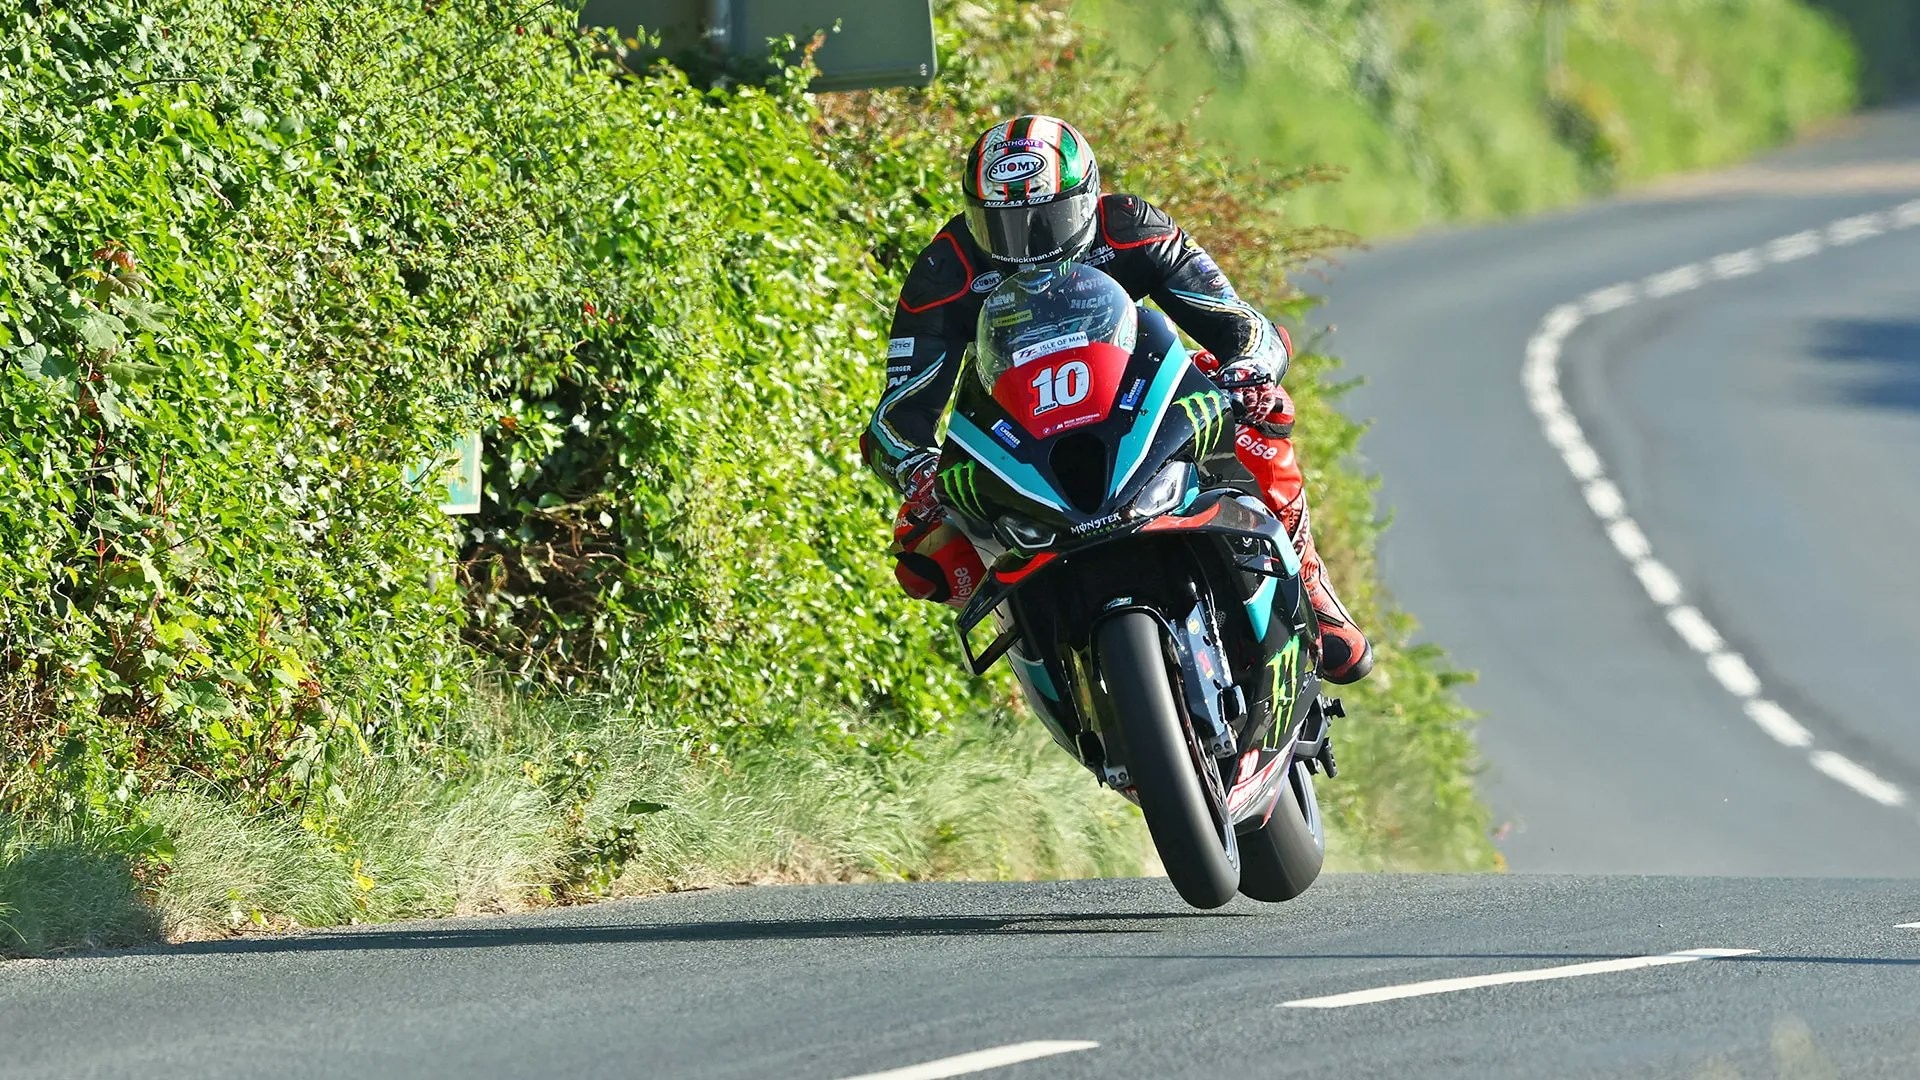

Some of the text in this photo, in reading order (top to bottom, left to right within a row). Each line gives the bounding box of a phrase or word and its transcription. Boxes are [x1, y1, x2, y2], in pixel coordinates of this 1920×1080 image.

[991, 161, 1040, 175] SUOMY
[991, 246, 1063, 263] peterhickman.net
[1070, 293, 1114, 310] HICKY
[1040, 341, 1056, 352] ISLE
[1057, 337, 1067, 346] OF
[1069, 334, 1087, 344] MAN
[1032, 360, 1091, 416] 10
[1070, 512, 1121, 534] MONSTER
